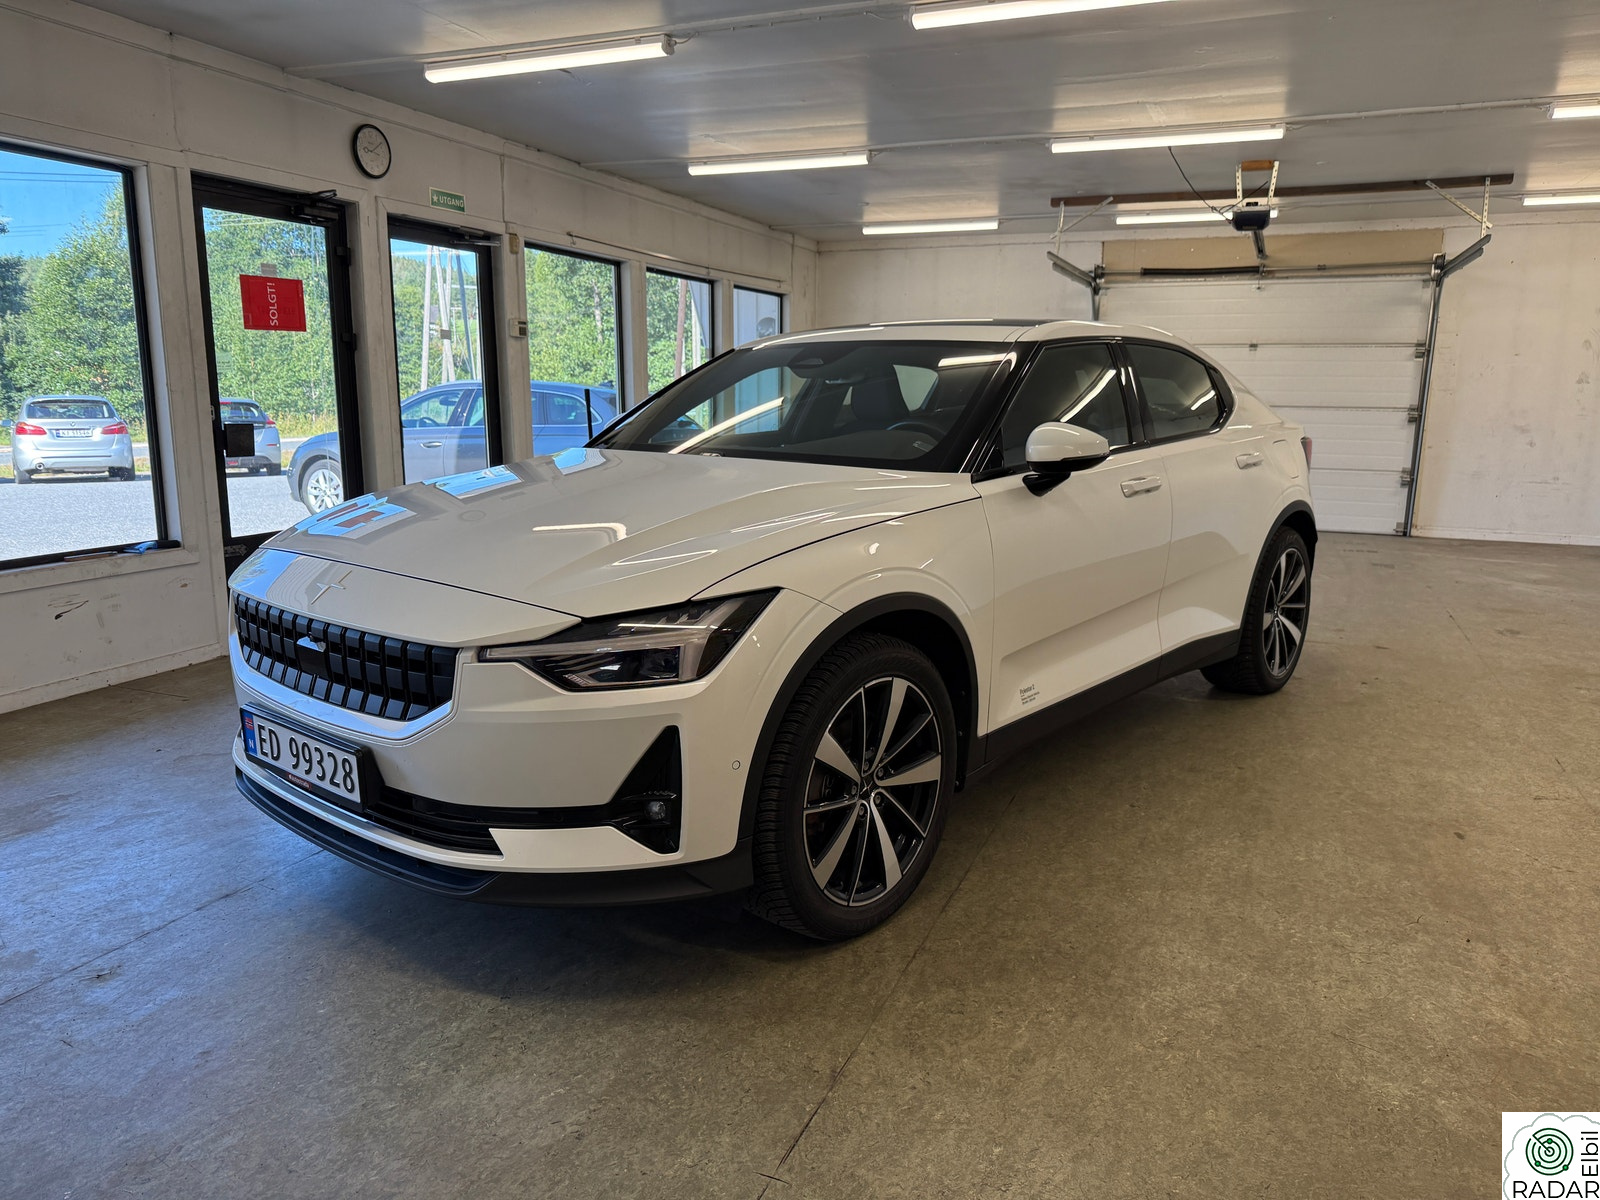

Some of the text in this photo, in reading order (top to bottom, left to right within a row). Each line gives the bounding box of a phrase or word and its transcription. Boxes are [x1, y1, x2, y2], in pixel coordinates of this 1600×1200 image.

[439, 195, 464, 208] UTGANG
[267, 282, 278, 326] SOLGT!
[248, 738, 255, 749] N
[257, 723, 355, 794] ED 99328
